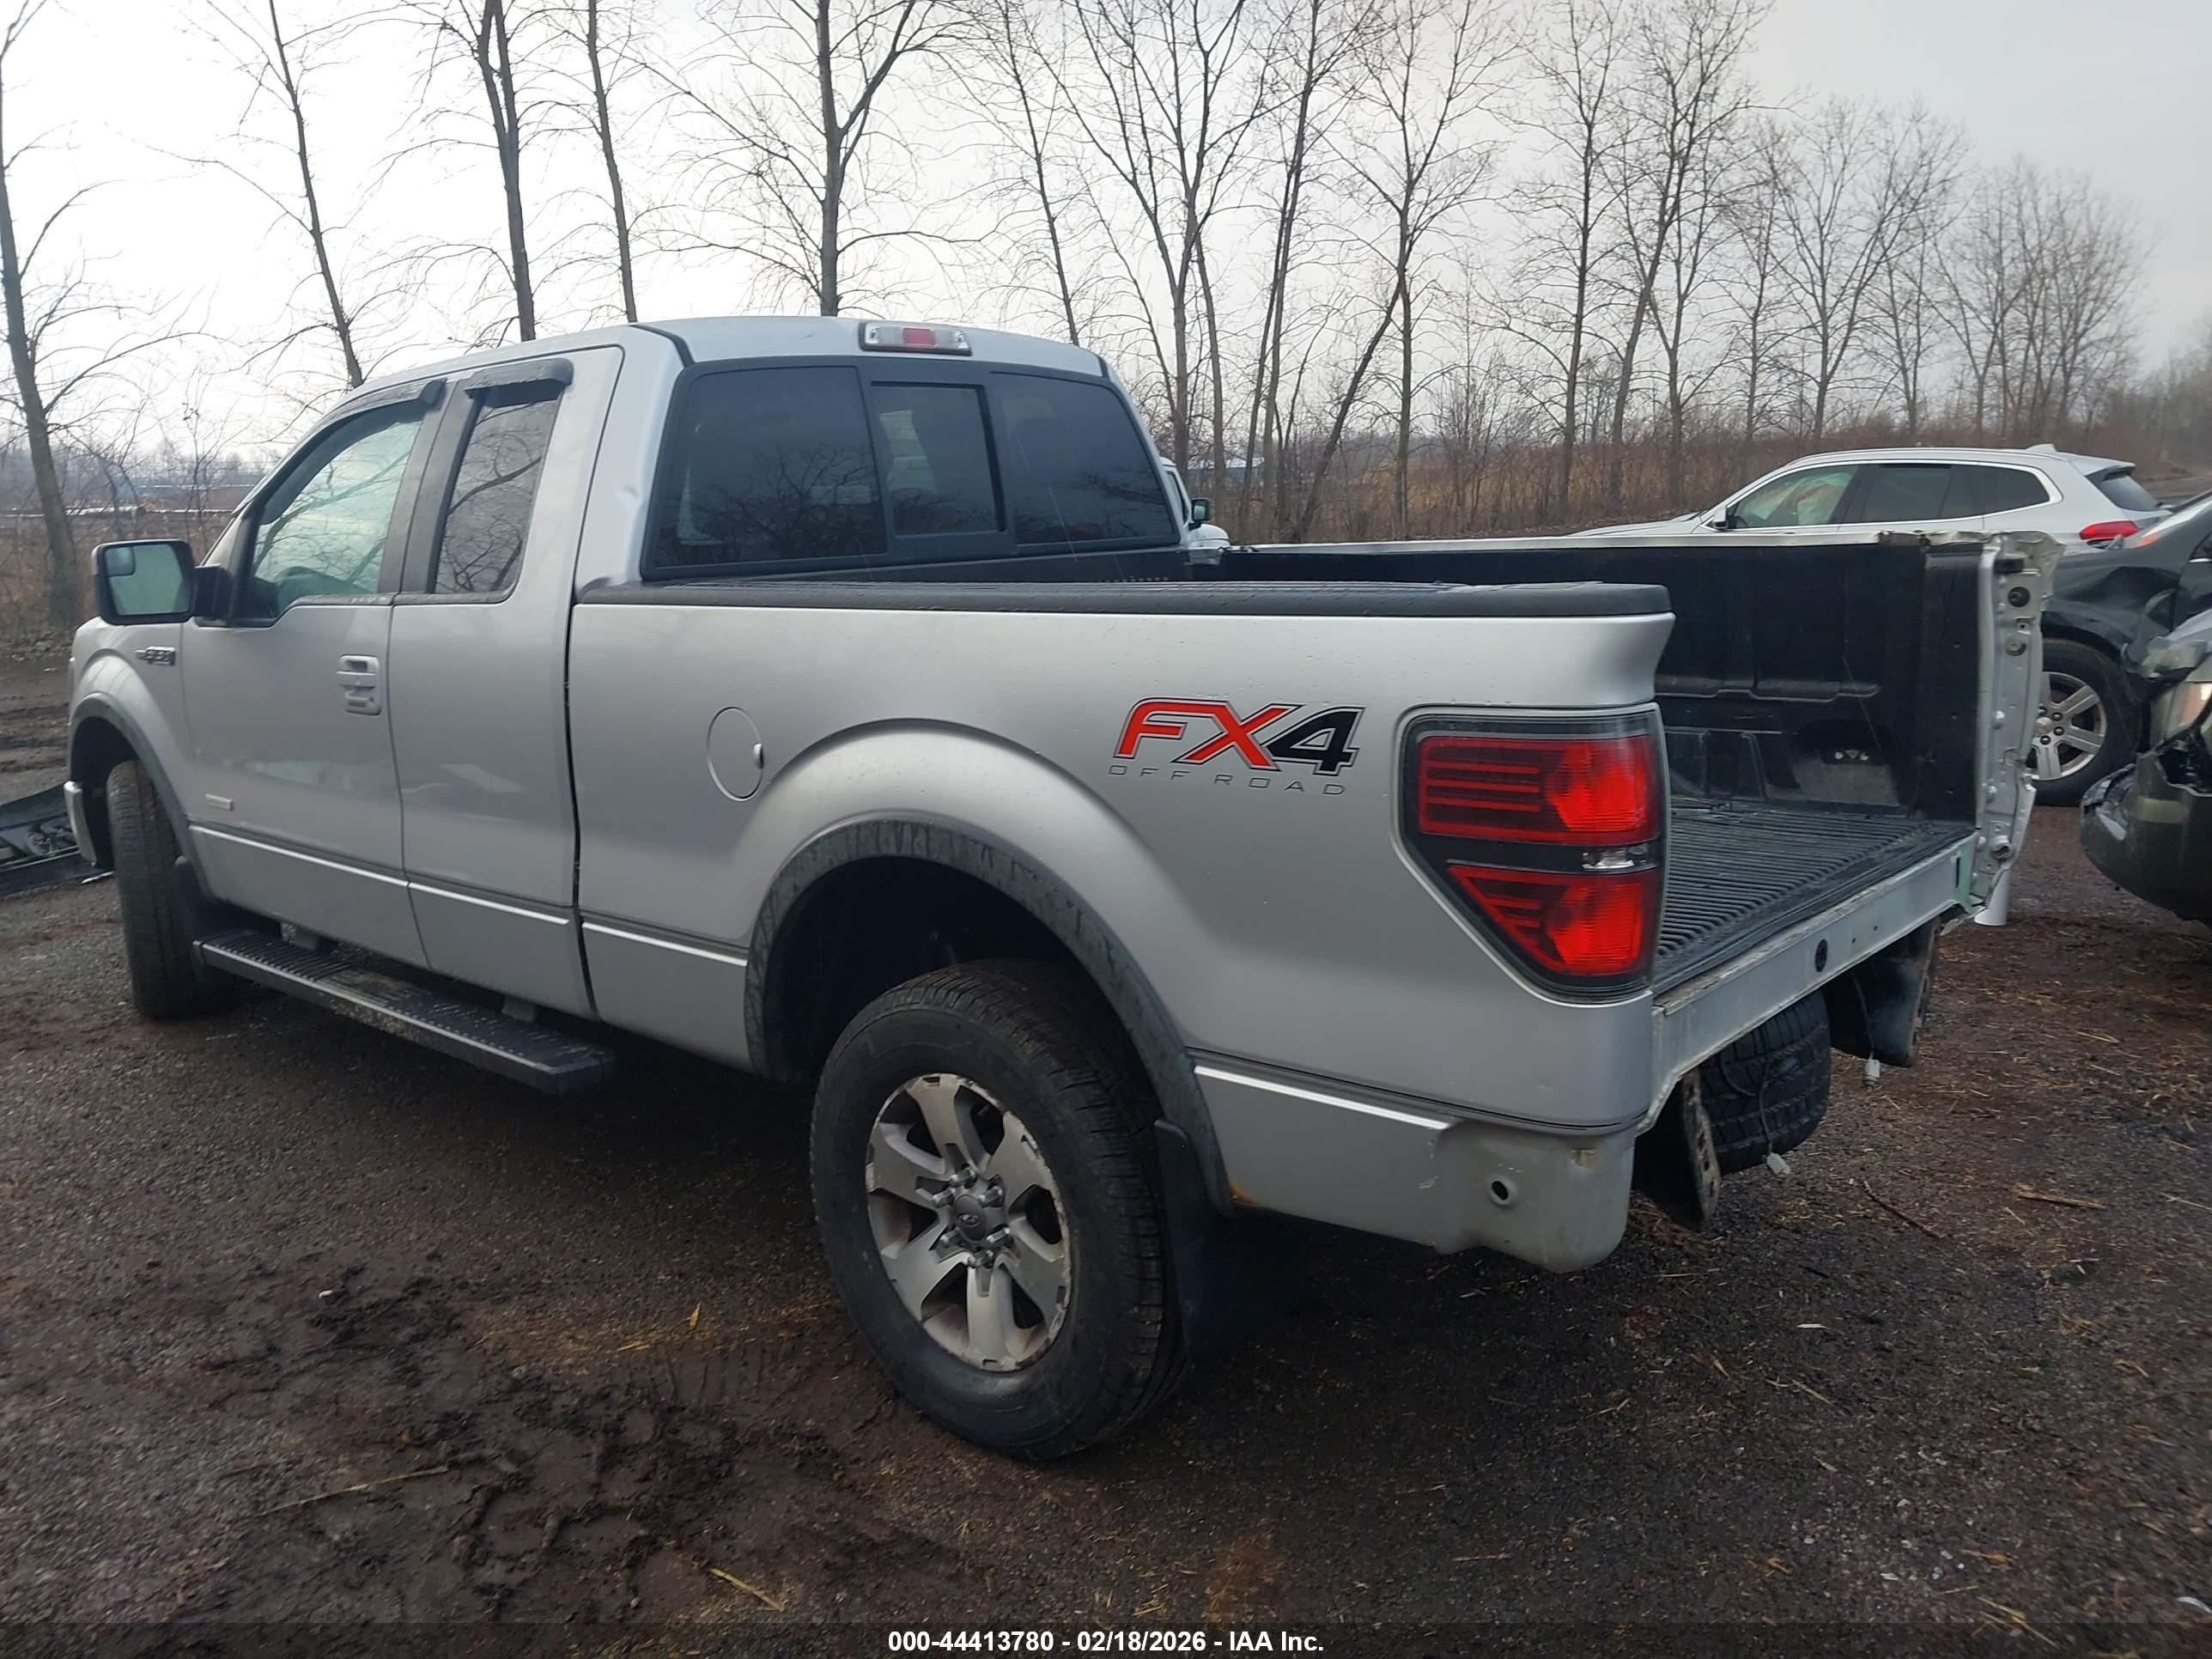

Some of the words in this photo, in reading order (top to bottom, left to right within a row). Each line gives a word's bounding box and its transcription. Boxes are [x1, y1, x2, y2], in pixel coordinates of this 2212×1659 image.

[1113, 696, 1367, 776] FX4
[1109, 764, 1190, 781] OFF
[1213, 773, 1346, 796] ROAD
